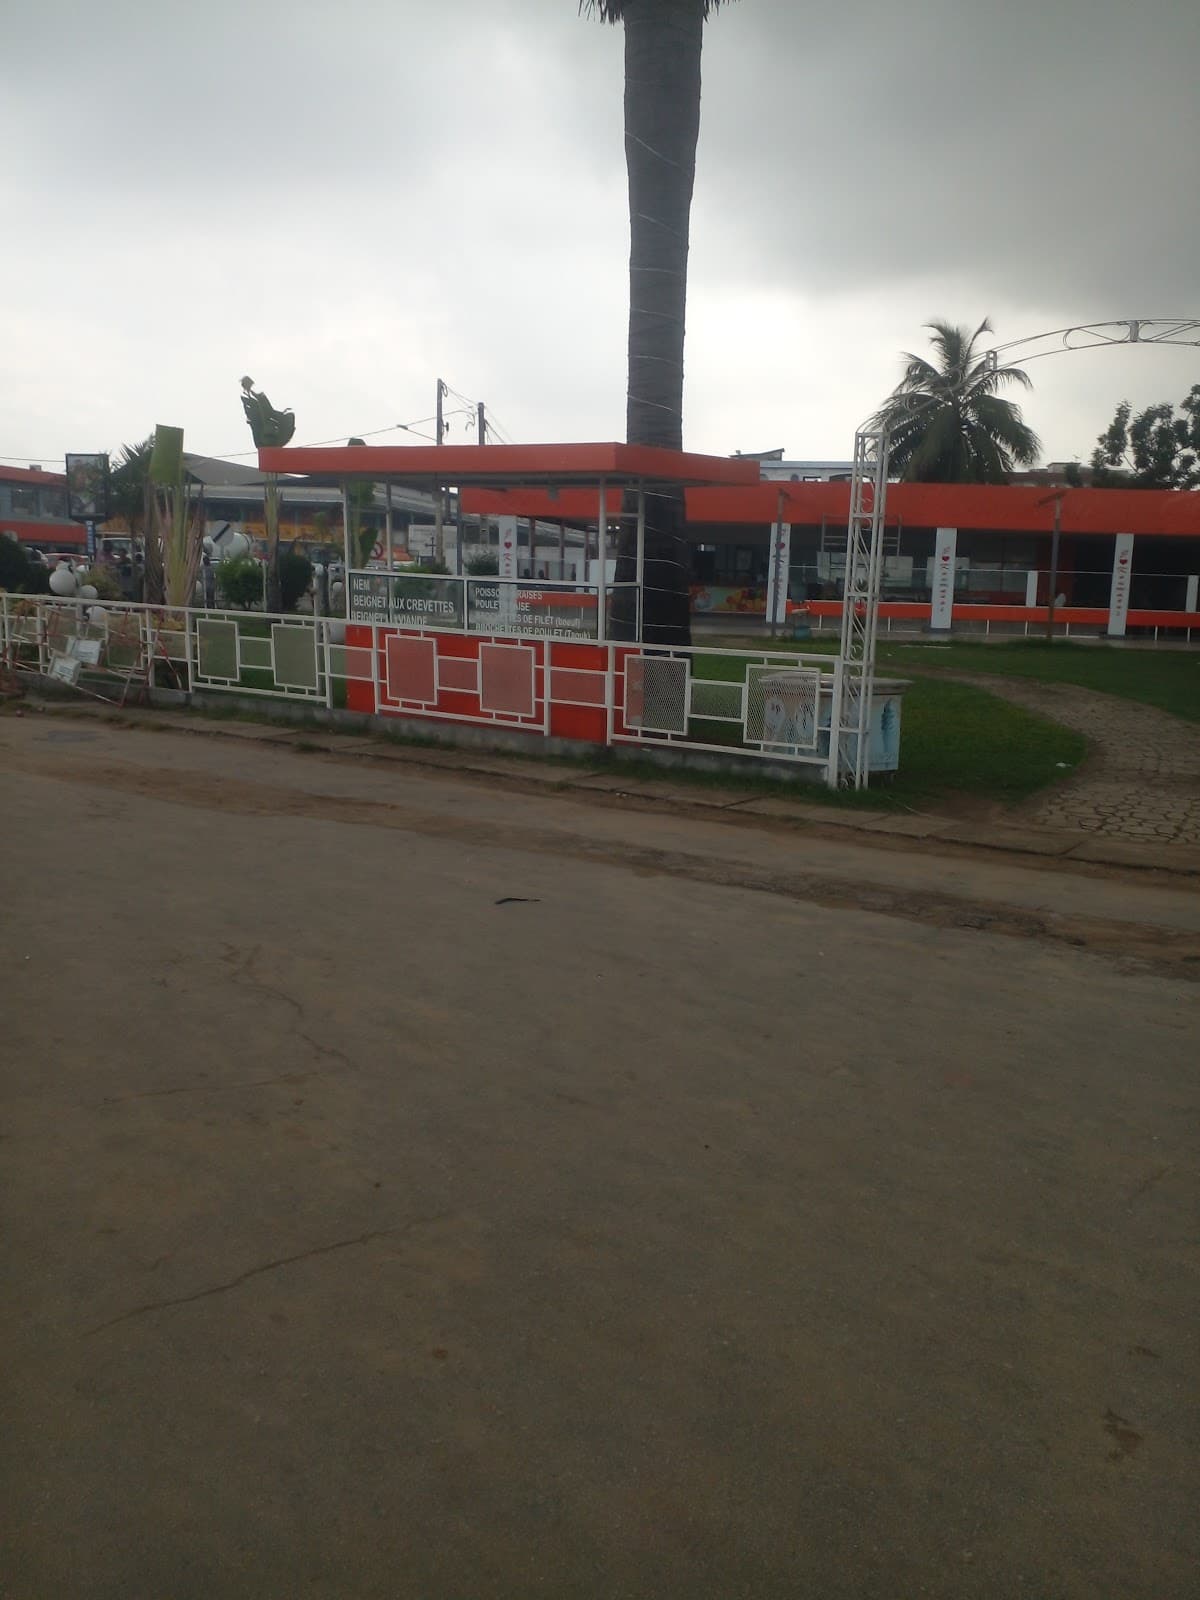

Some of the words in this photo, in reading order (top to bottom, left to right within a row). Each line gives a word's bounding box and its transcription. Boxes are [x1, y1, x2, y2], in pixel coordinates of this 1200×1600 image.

[353, 578, 370, 591] NEM
[475, 587, 506, 598] POISSO
[514, 591, 543, 600] RAISES
[353, 595, 386, 609] BEIGNET
[388, 597, 405, 610] AUX
[406, 598, 454, 614] CREVETTES
[475, 599, 502, 609] POULE
[534, 615, 554, 625] FILET
